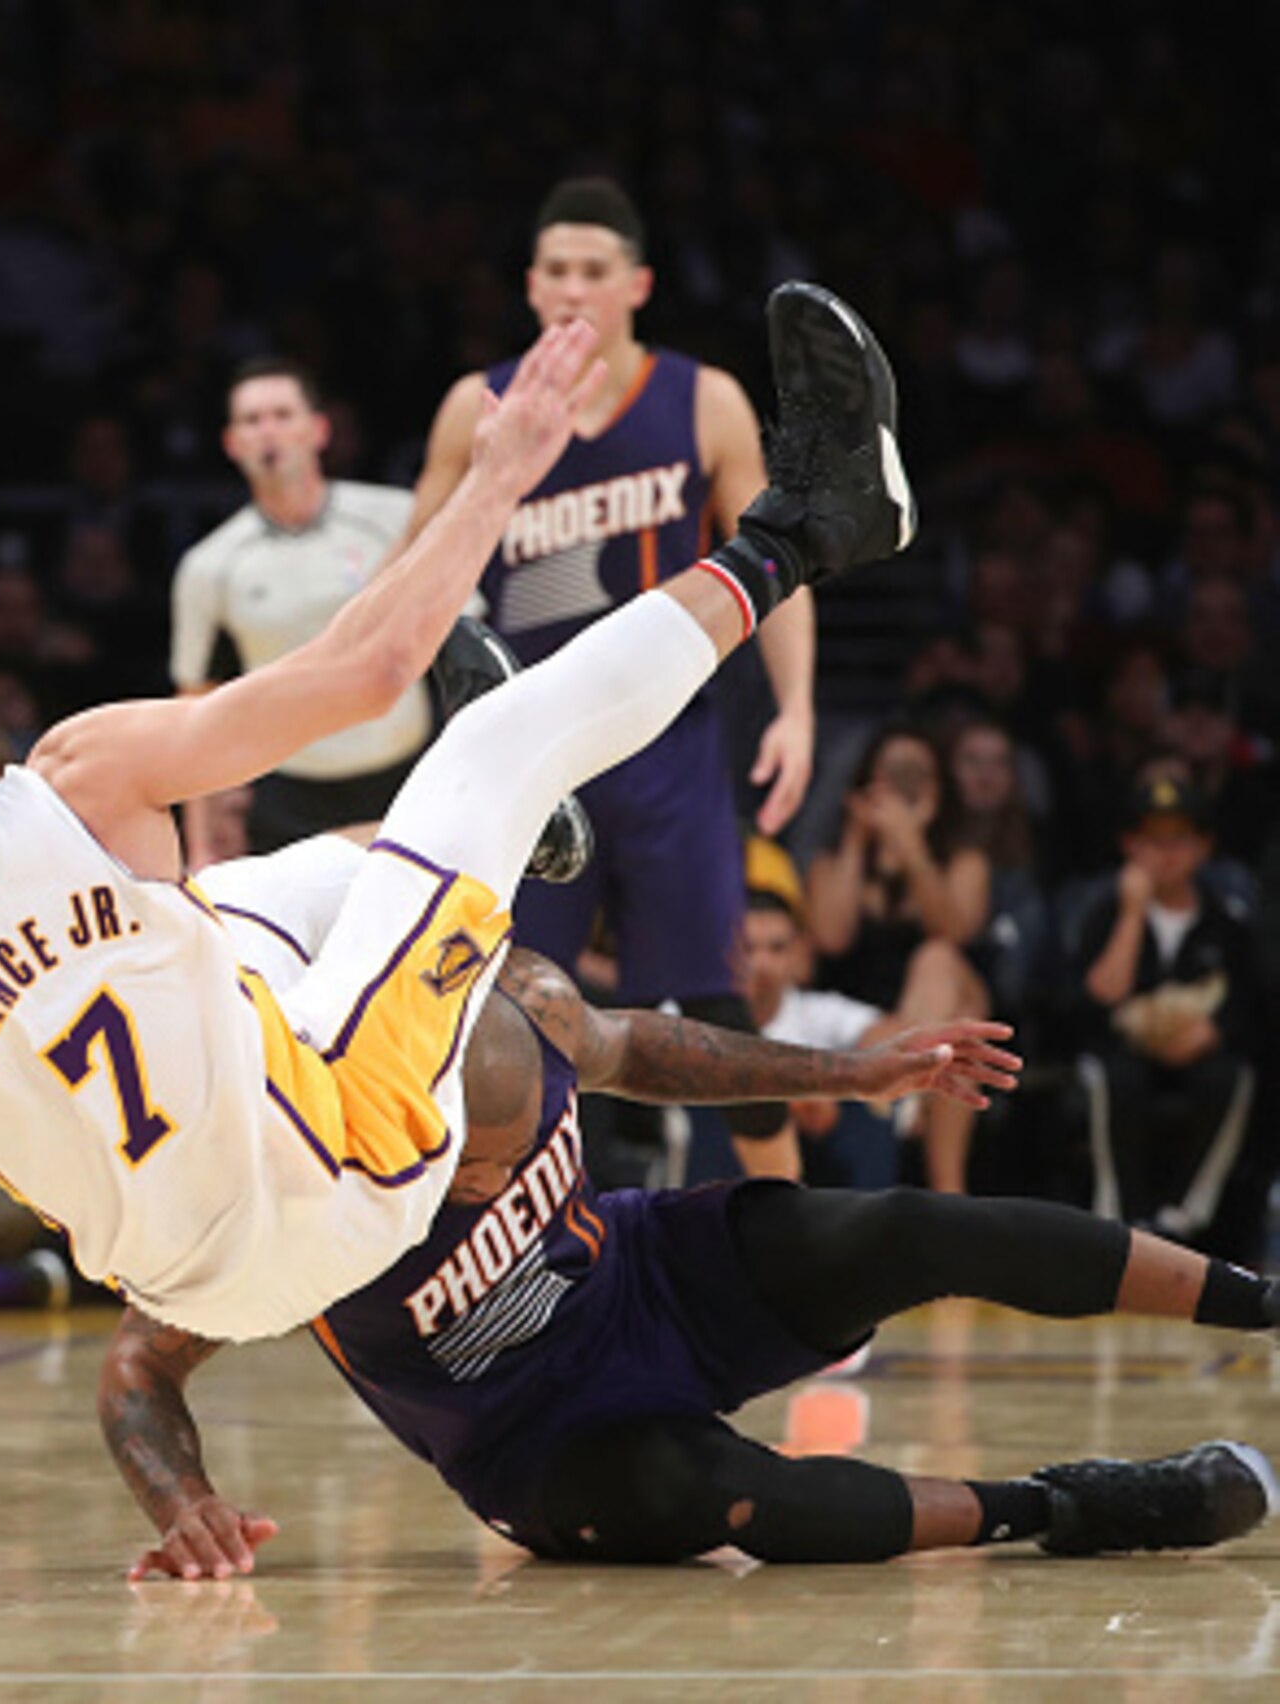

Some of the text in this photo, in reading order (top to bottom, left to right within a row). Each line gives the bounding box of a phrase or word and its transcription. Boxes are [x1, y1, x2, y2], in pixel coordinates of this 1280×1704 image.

[502, 460, 690, 567] PHOENIX
[67, 885, 142, 949] JR.
[36, 980, 183, 1174] 7
